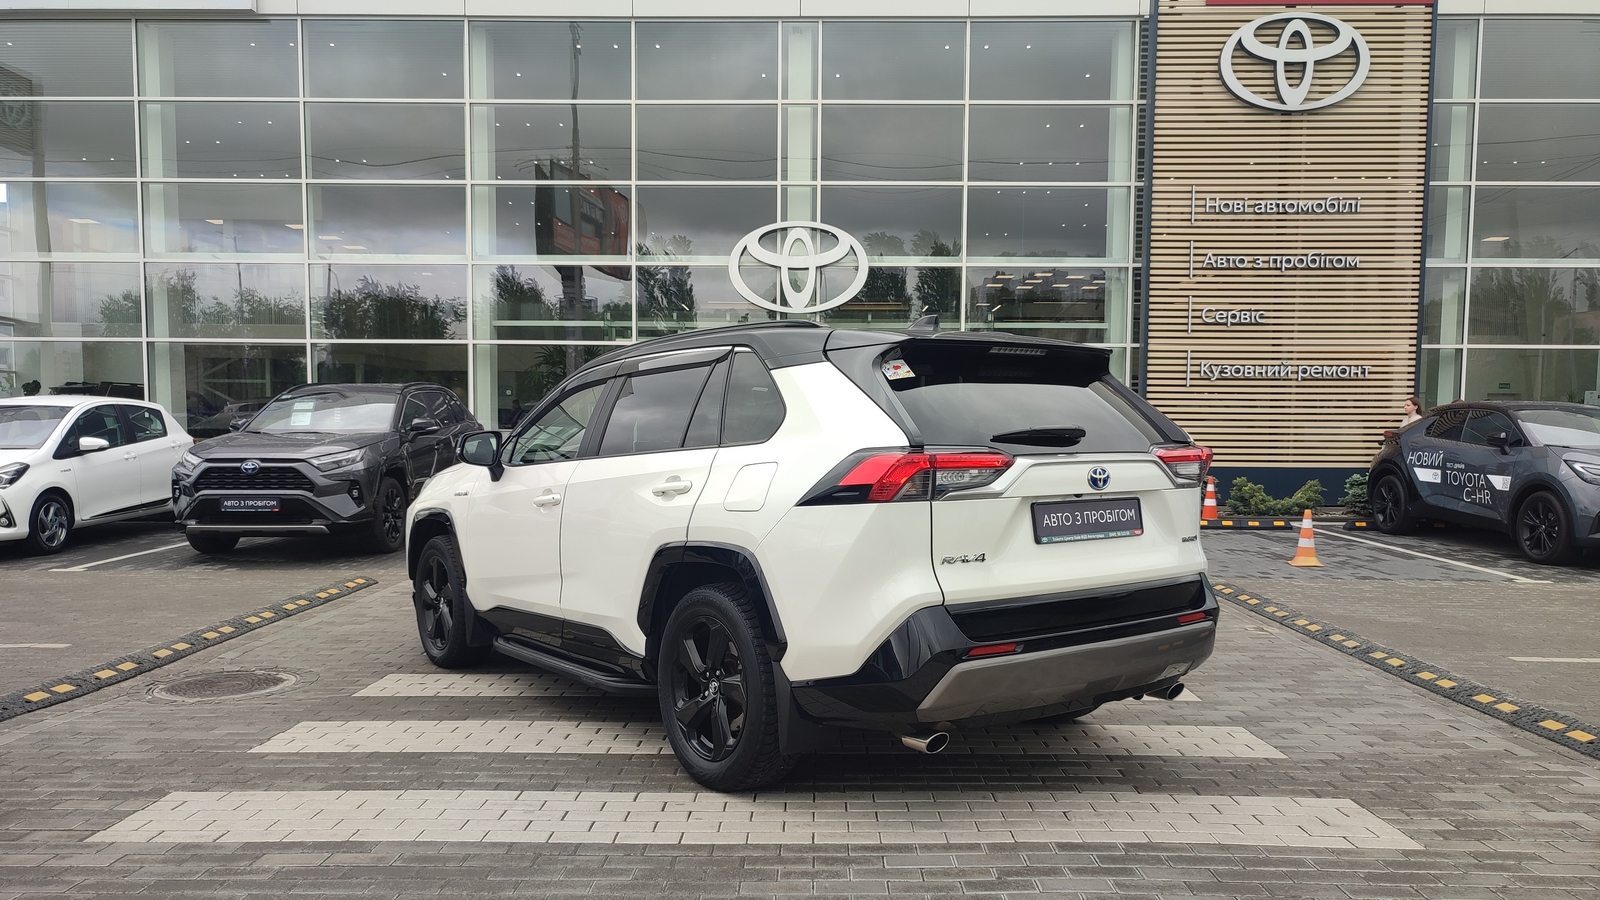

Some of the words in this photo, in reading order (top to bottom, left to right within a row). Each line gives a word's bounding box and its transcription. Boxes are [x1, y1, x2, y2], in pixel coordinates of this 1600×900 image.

[1205, 197, 1249, 214] Нові
[1254, 196, 1362, 214] автомобілі
[1202, 252, 1248, 269] Авто
[1252, 256, 1263, 269] з
[1269, 252, 1360, 272] пробігом
[1201, 307, 1267, 327] Сервіс
[1200, 361, 1292, 381] Кузовний
[1297, 364, 1372, 382] ремонт
[1407, 450, 1444, 467] НОВИЙ
[1446, 470, 1487, 489] TOYOTA
[1463, 487, 1492, 505] C-HR
[1043, 512, 1072, 528] АВТО
[1074, 512, 1082, 525] З
[1083, 508, 1136, 524] ПРОБІГОМ
[940, 551, 986, 566] RAV4
